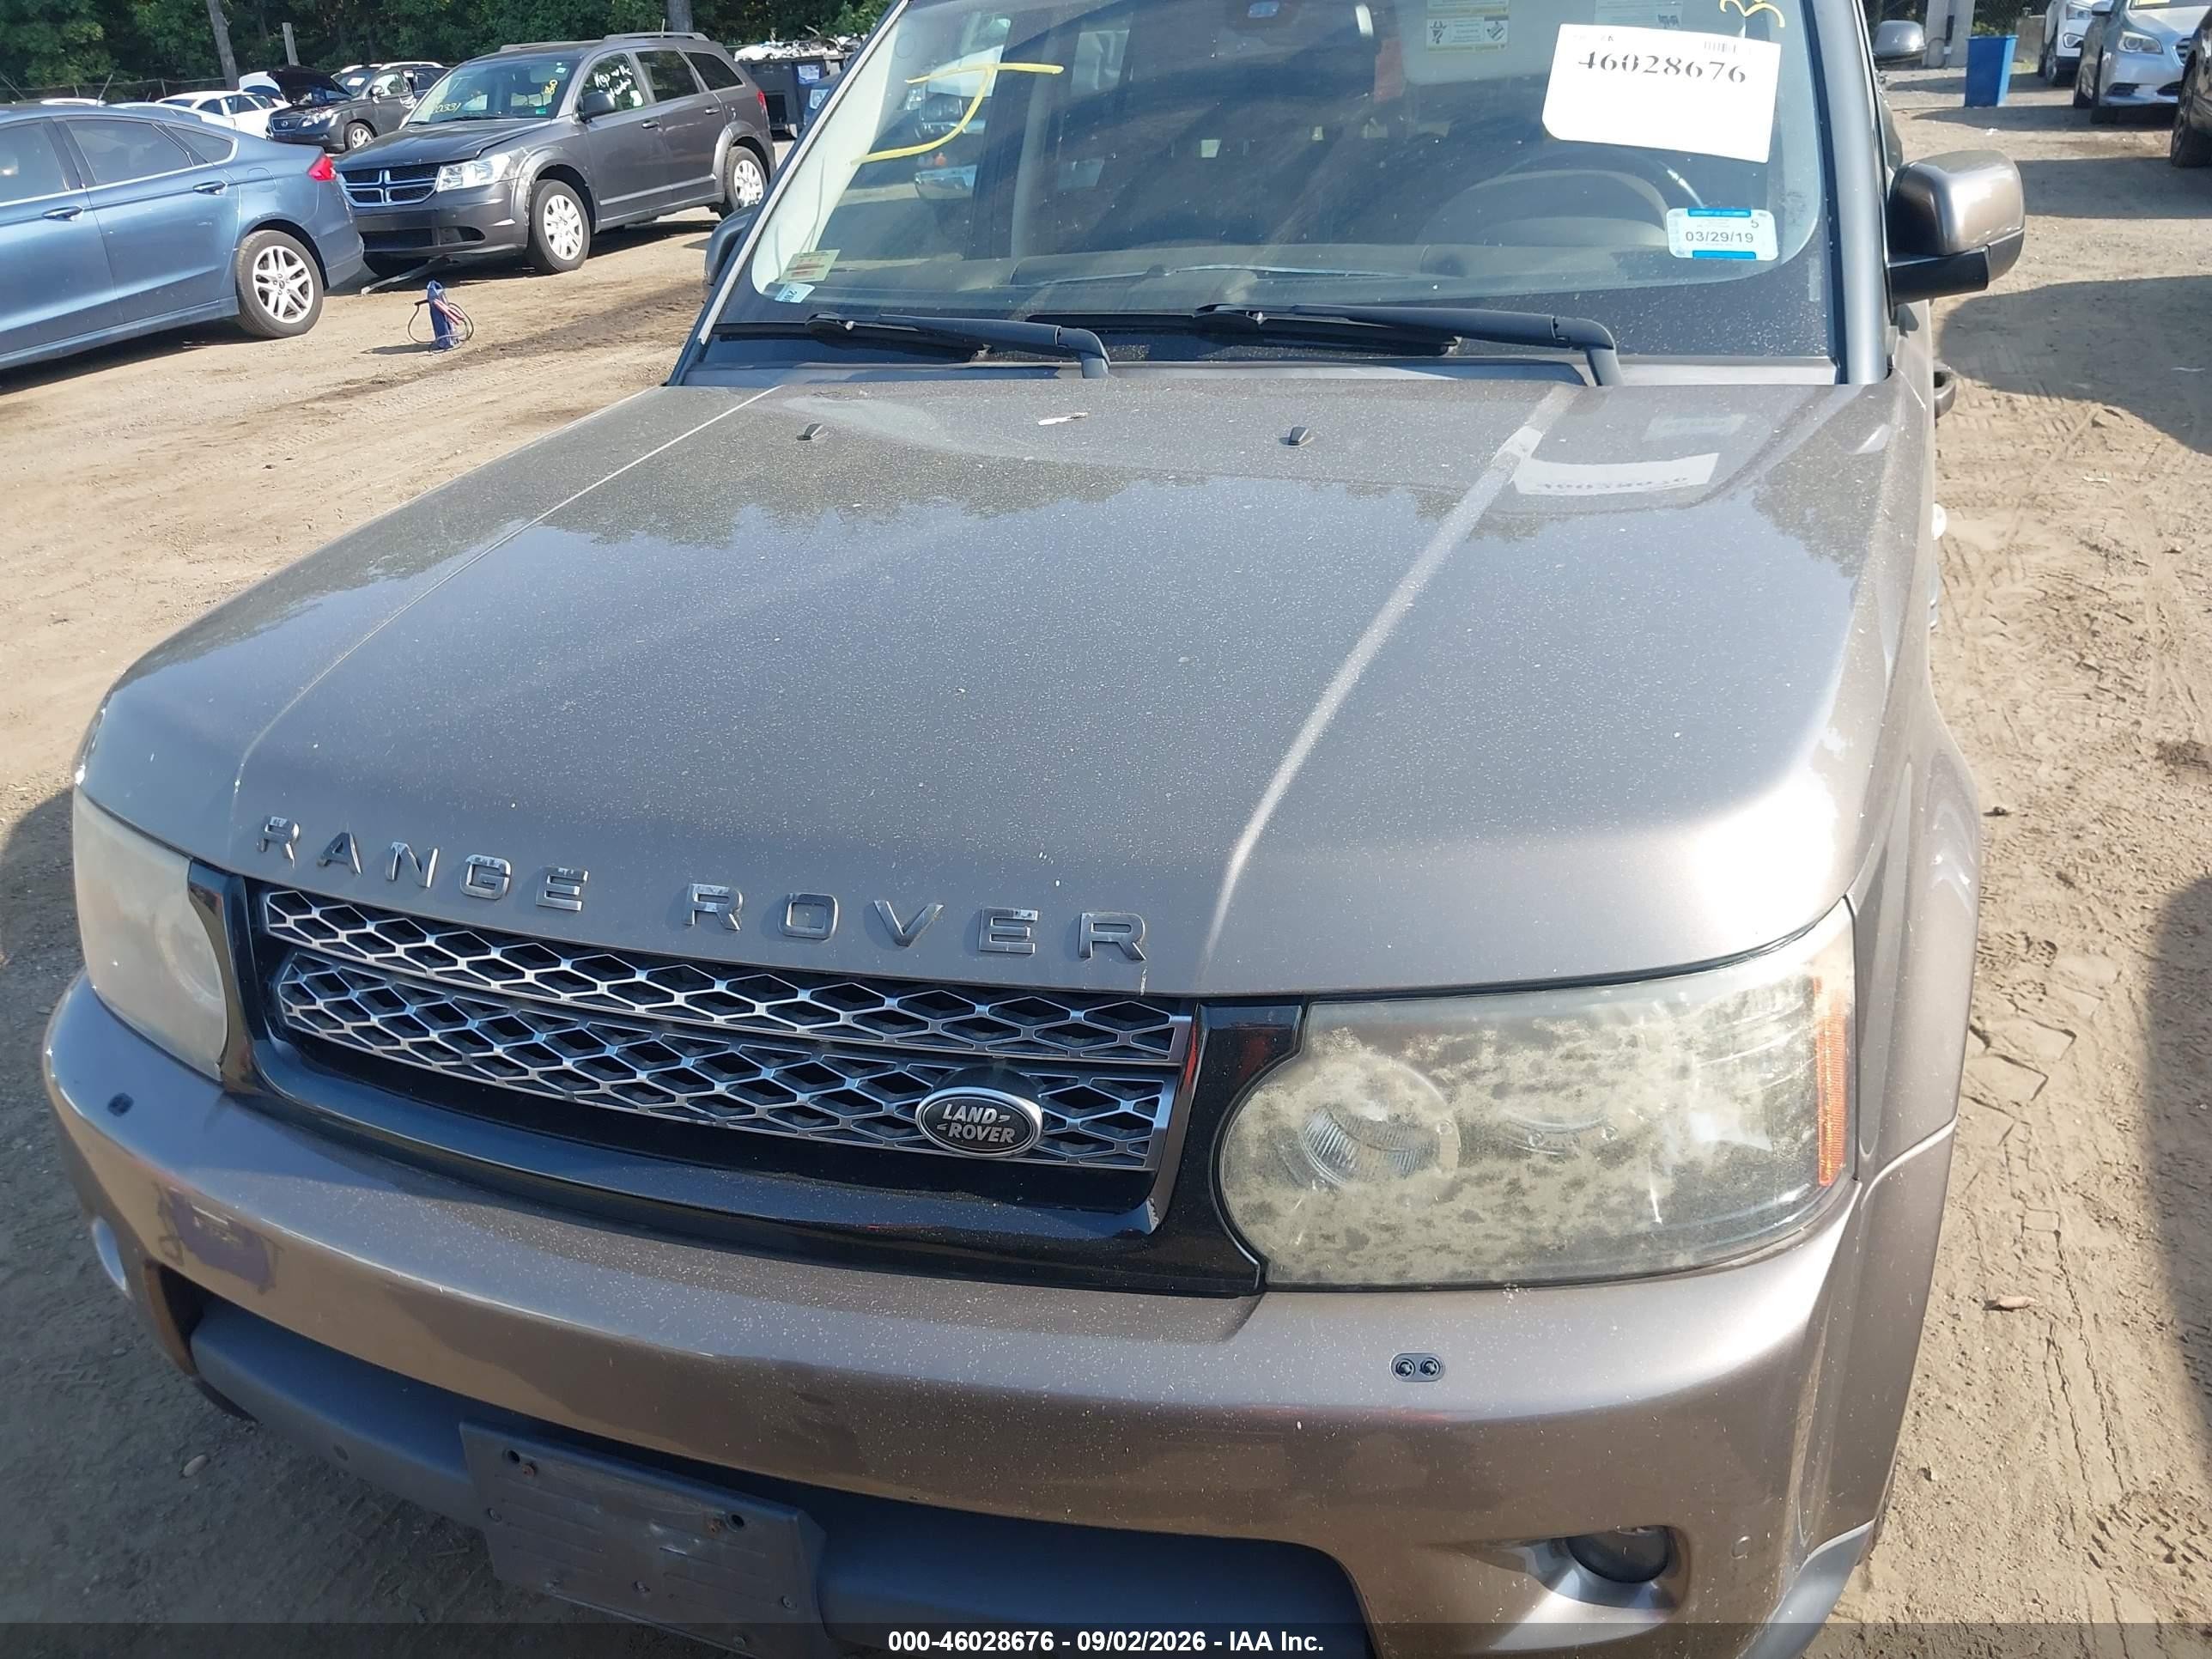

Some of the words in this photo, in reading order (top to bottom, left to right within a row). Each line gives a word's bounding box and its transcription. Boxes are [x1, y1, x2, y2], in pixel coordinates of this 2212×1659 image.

[1578, 52, 1746, 83] 46028676
[1750, 218, 1760, 228] 5
[1685, 230, 1754, 243] 03/29/19
[258, 814, 590, 914] RANGE
[683, 883, 1148, 962] ROVER
